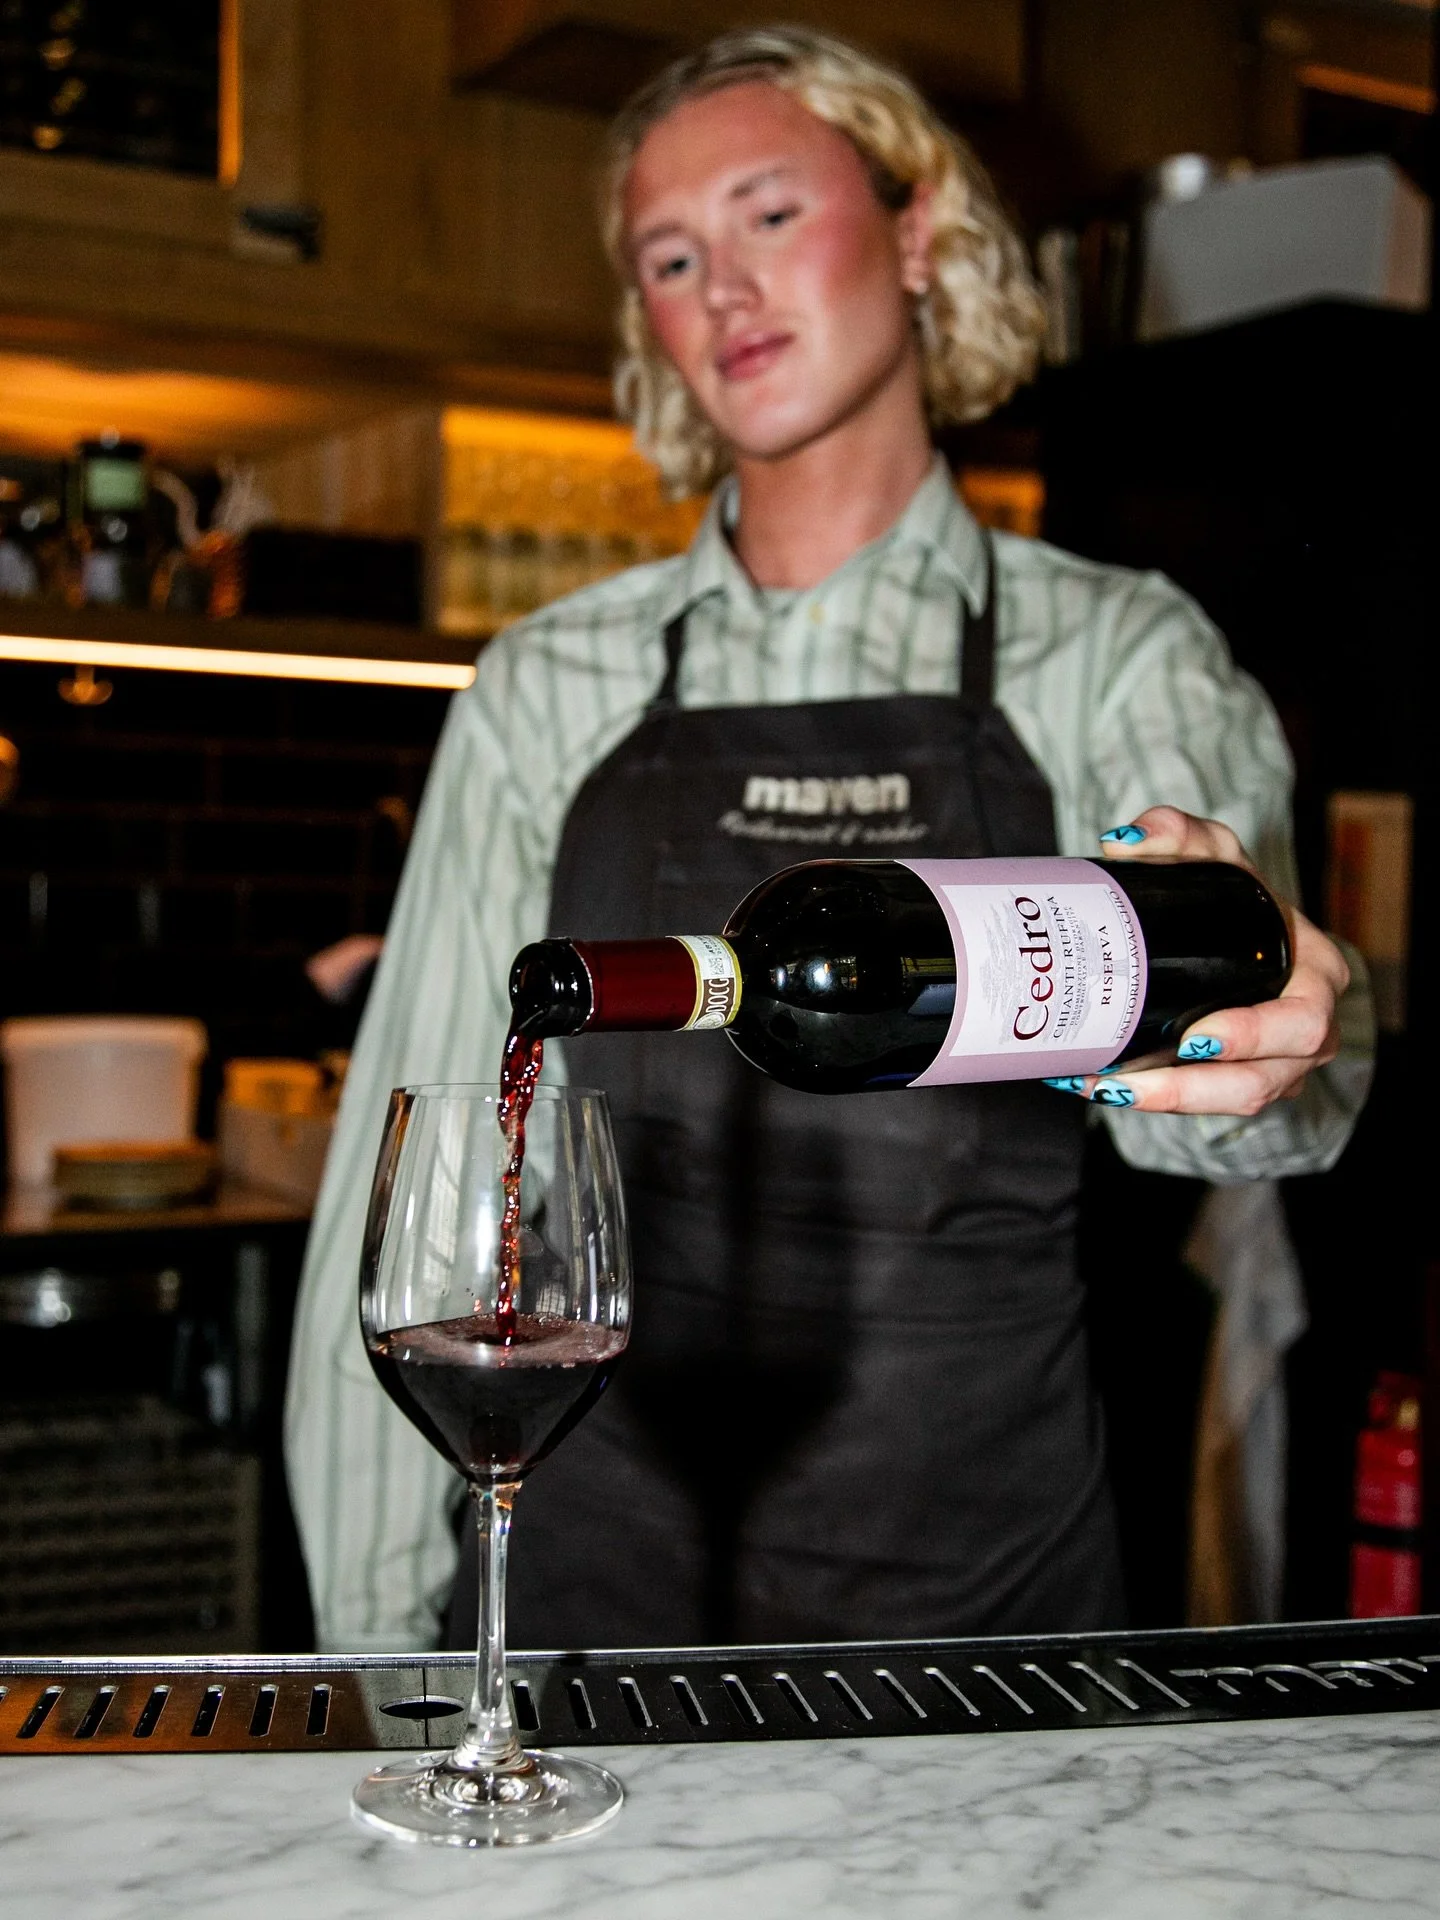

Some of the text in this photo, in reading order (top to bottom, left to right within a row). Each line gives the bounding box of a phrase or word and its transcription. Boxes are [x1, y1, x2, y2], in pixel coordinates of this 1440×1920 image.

[706, 978, 730, 1013] DOCG
[1013, 896, 1054, 1041] Cedro
[1047, 895, 1075, 1038] CHIANTI RUFINA
[1098, 924, 1114, 1006] RISERVA
[1109, 890, 1140, 1040] FATTORIA LAVACCHIO
